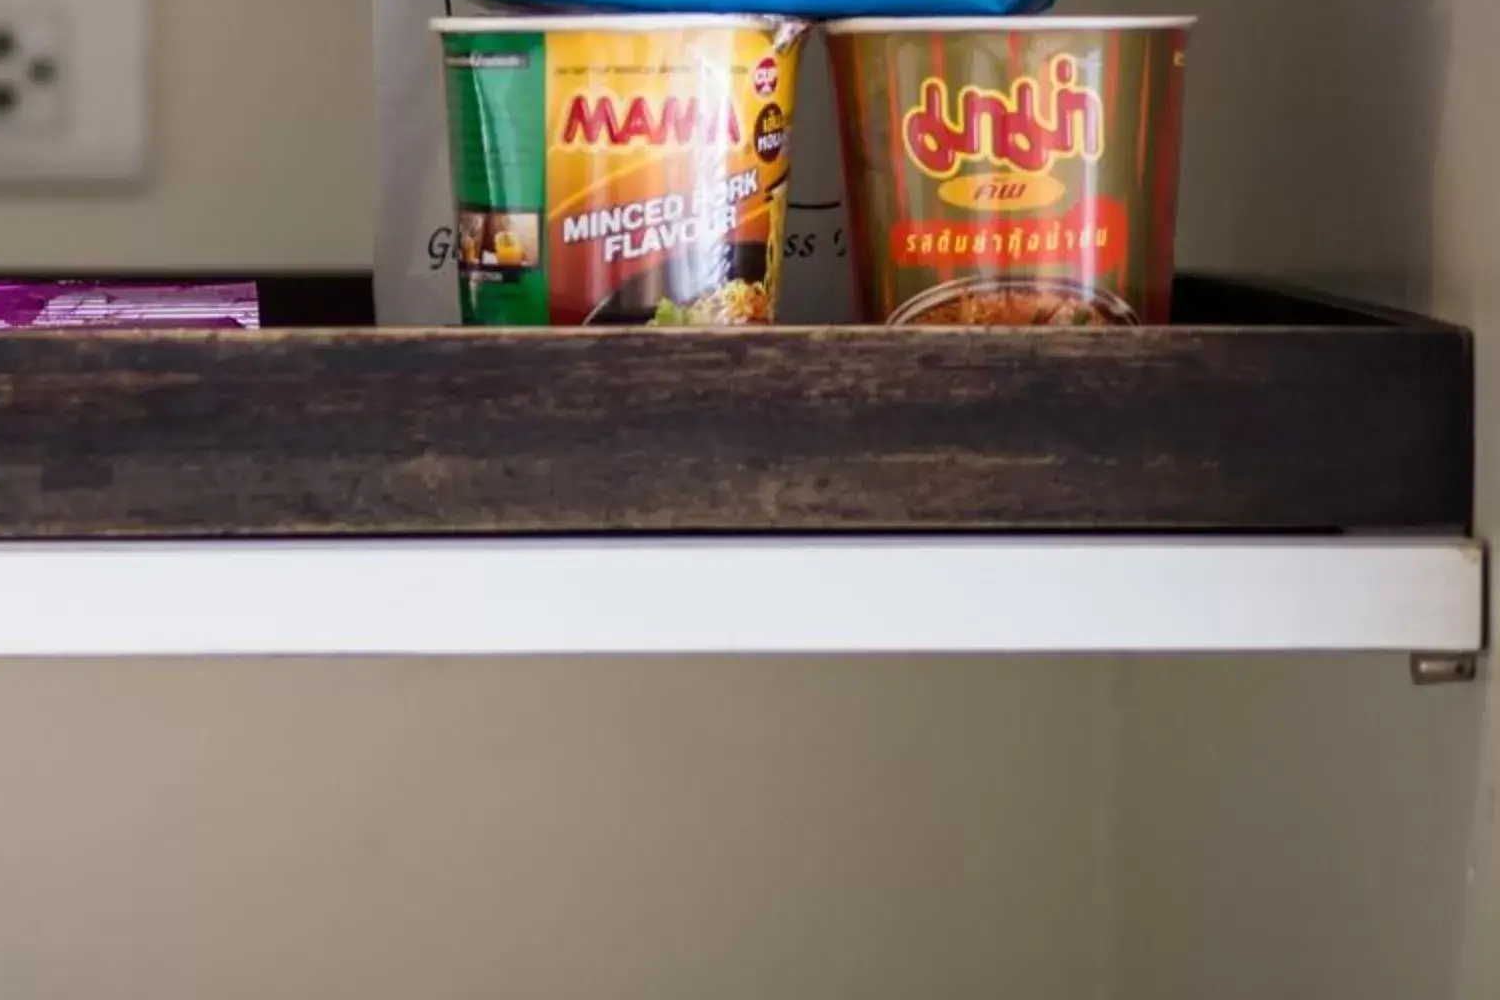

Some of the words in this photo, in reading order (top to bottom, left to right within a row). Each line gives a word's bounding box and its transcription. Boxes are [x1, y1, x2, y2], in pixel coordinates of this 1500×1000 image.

[563, 95, 741, 145] MAMA
[903, 53, 1104, 178] มาม่า
[563, 194, 684, 243] MINCED
